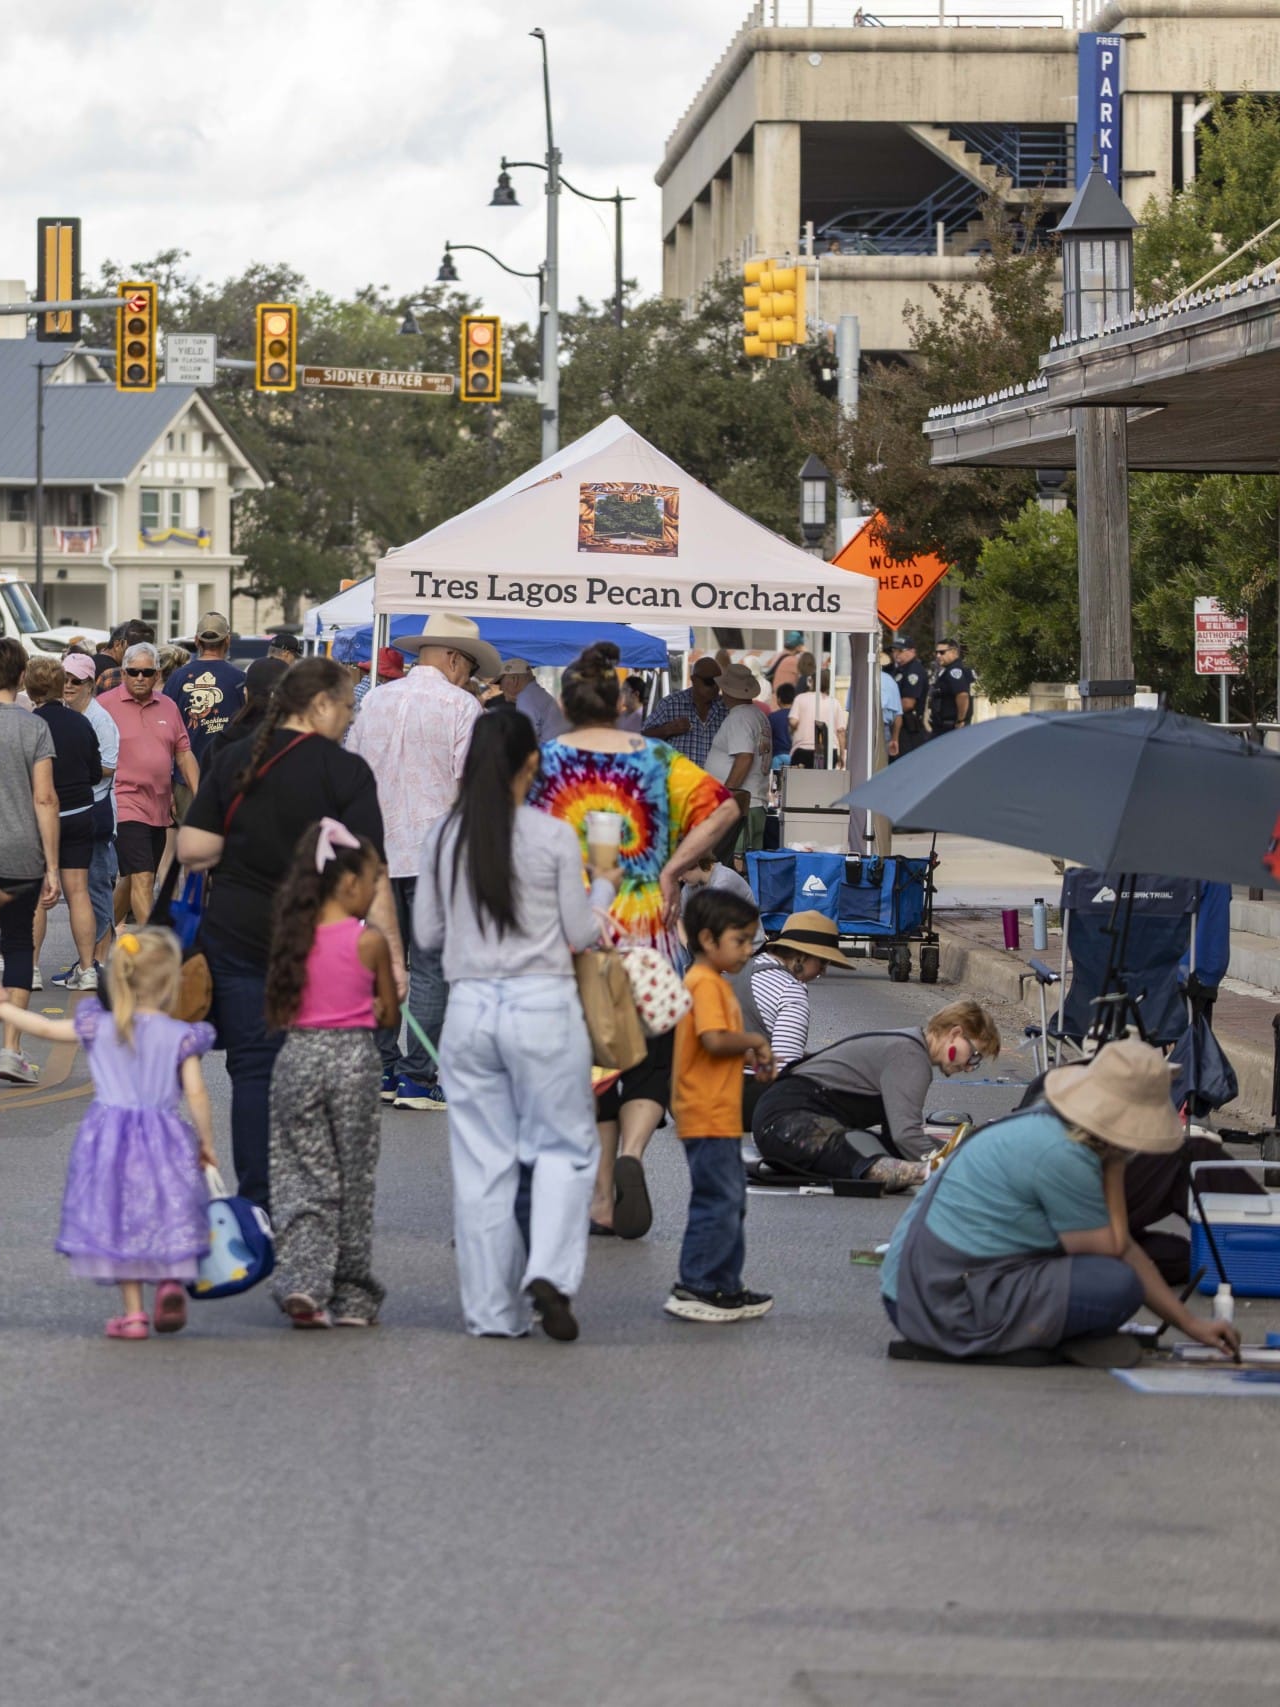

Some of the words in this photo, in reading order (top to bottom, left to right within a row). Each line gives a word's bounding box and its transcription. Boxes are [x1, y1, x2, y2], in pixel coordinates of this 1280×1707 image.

[1096, 37, 1119, 46] FREE
[1100, 51, 1113, 184] PARKI
[178, 347, 204, 355] YIELD
[323, 369, 375, 384] SIDNEY
[378, 372, 423, 387] BAKER
[878, 573, 924, 590] HEAD
[410, 570, 479, 600] Tres
[487, 574, 577, 608] Lagos
[586, 577, 682, 608] Pecan
[691, 582, 841, 613] Orchards
